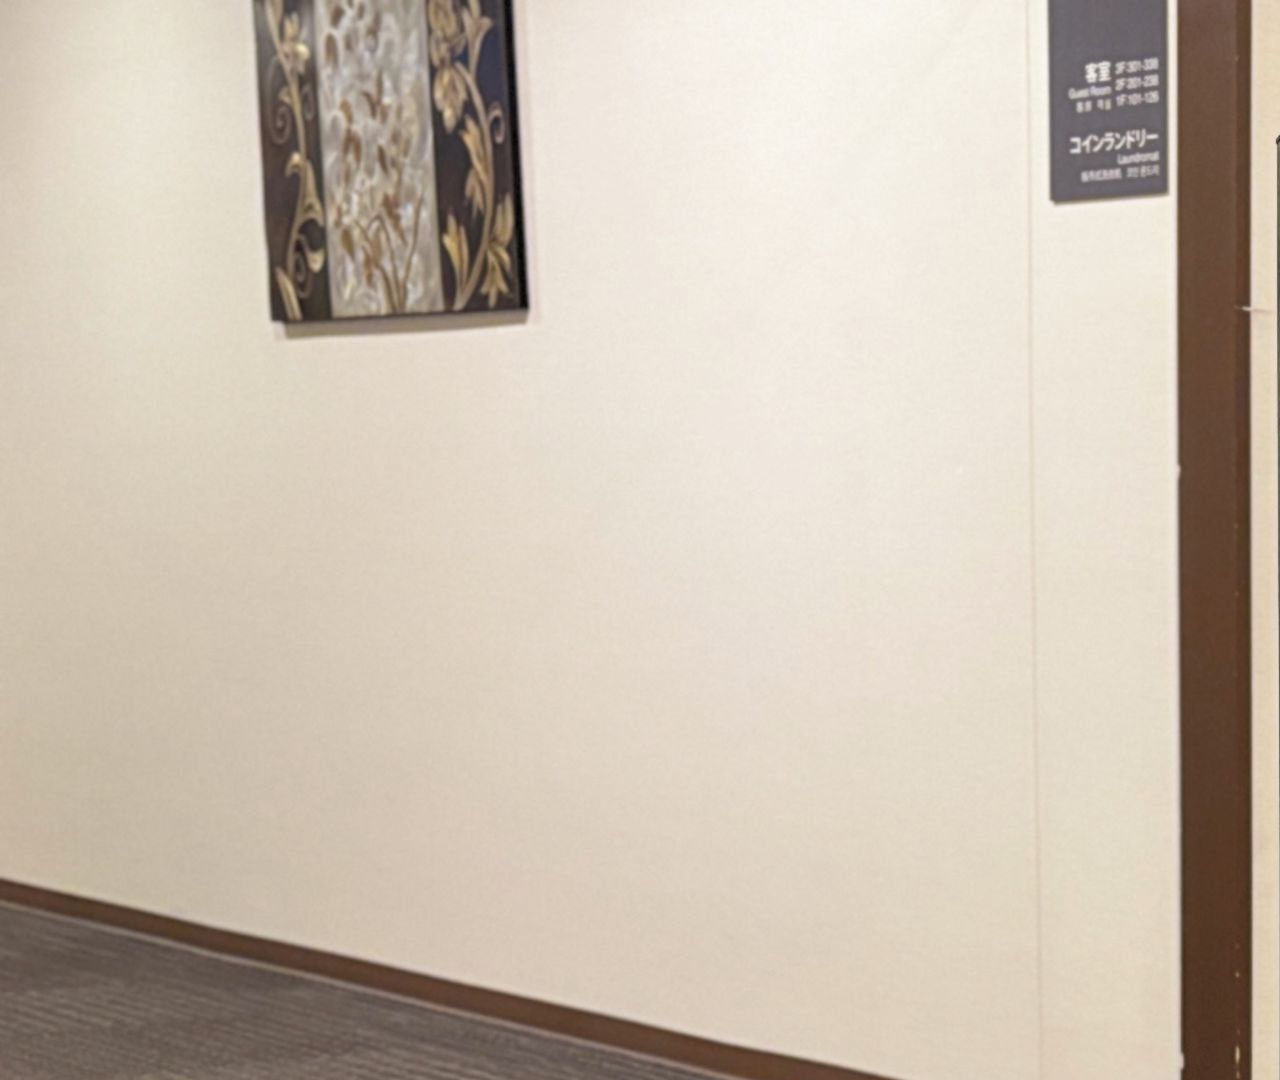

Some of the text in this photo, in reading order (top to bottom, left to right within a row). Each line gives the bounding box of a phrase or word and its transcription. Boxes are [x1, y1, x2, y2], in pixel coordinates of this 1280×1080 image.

[1085, 61, 1111, 83] 客室
[1069, 128, 1159, 154] コインランドリー
